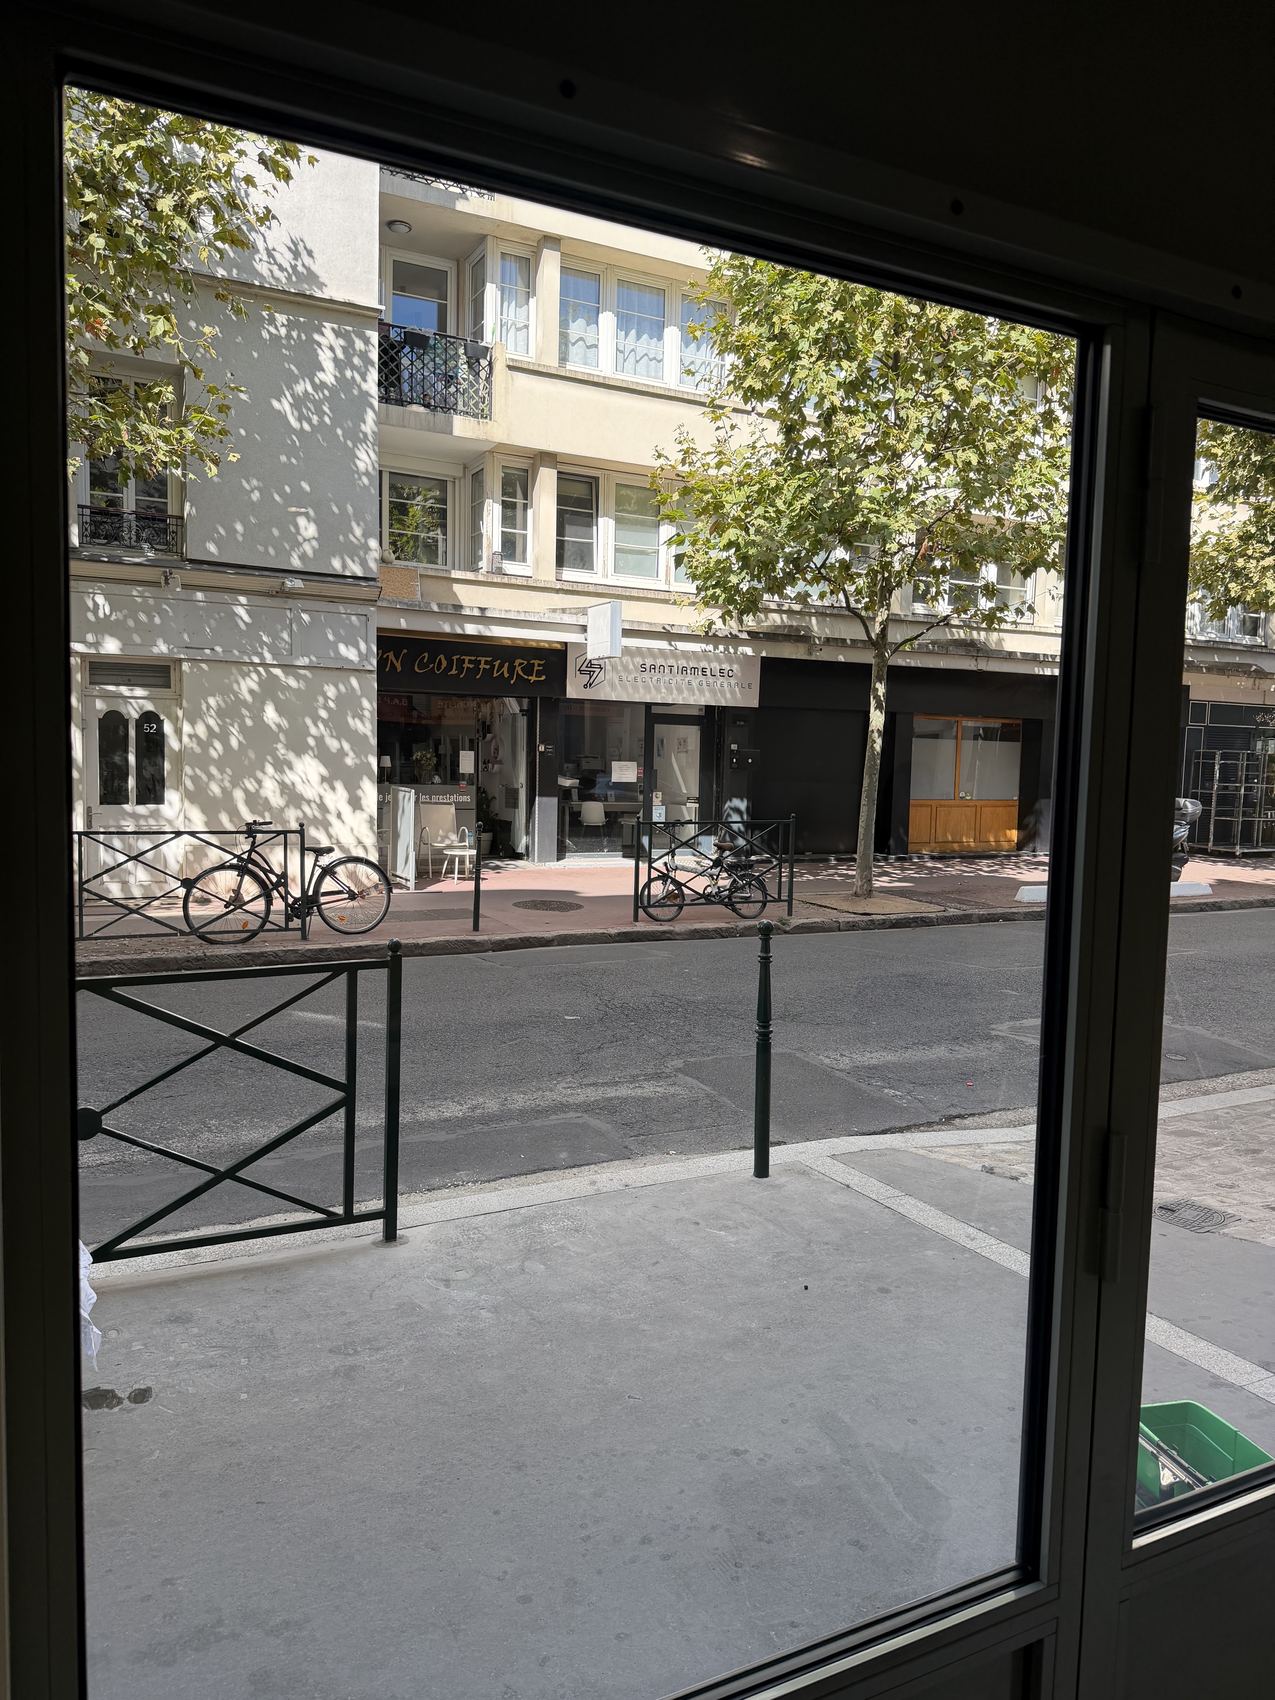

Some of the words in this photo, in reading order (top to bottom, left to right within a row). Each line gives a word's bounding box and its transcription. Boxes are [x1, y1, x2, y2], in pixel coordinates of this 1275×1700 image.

[414, 652, 546, 684] COIFFURE
[640, 663, 734, 678] SANTIAMELEC
[698, 679, 753, 690] GENERALE
[143, 723, 157, 733] 52
[419, 793, 430, 801] les
[431, 793, 471, 803] prestations
